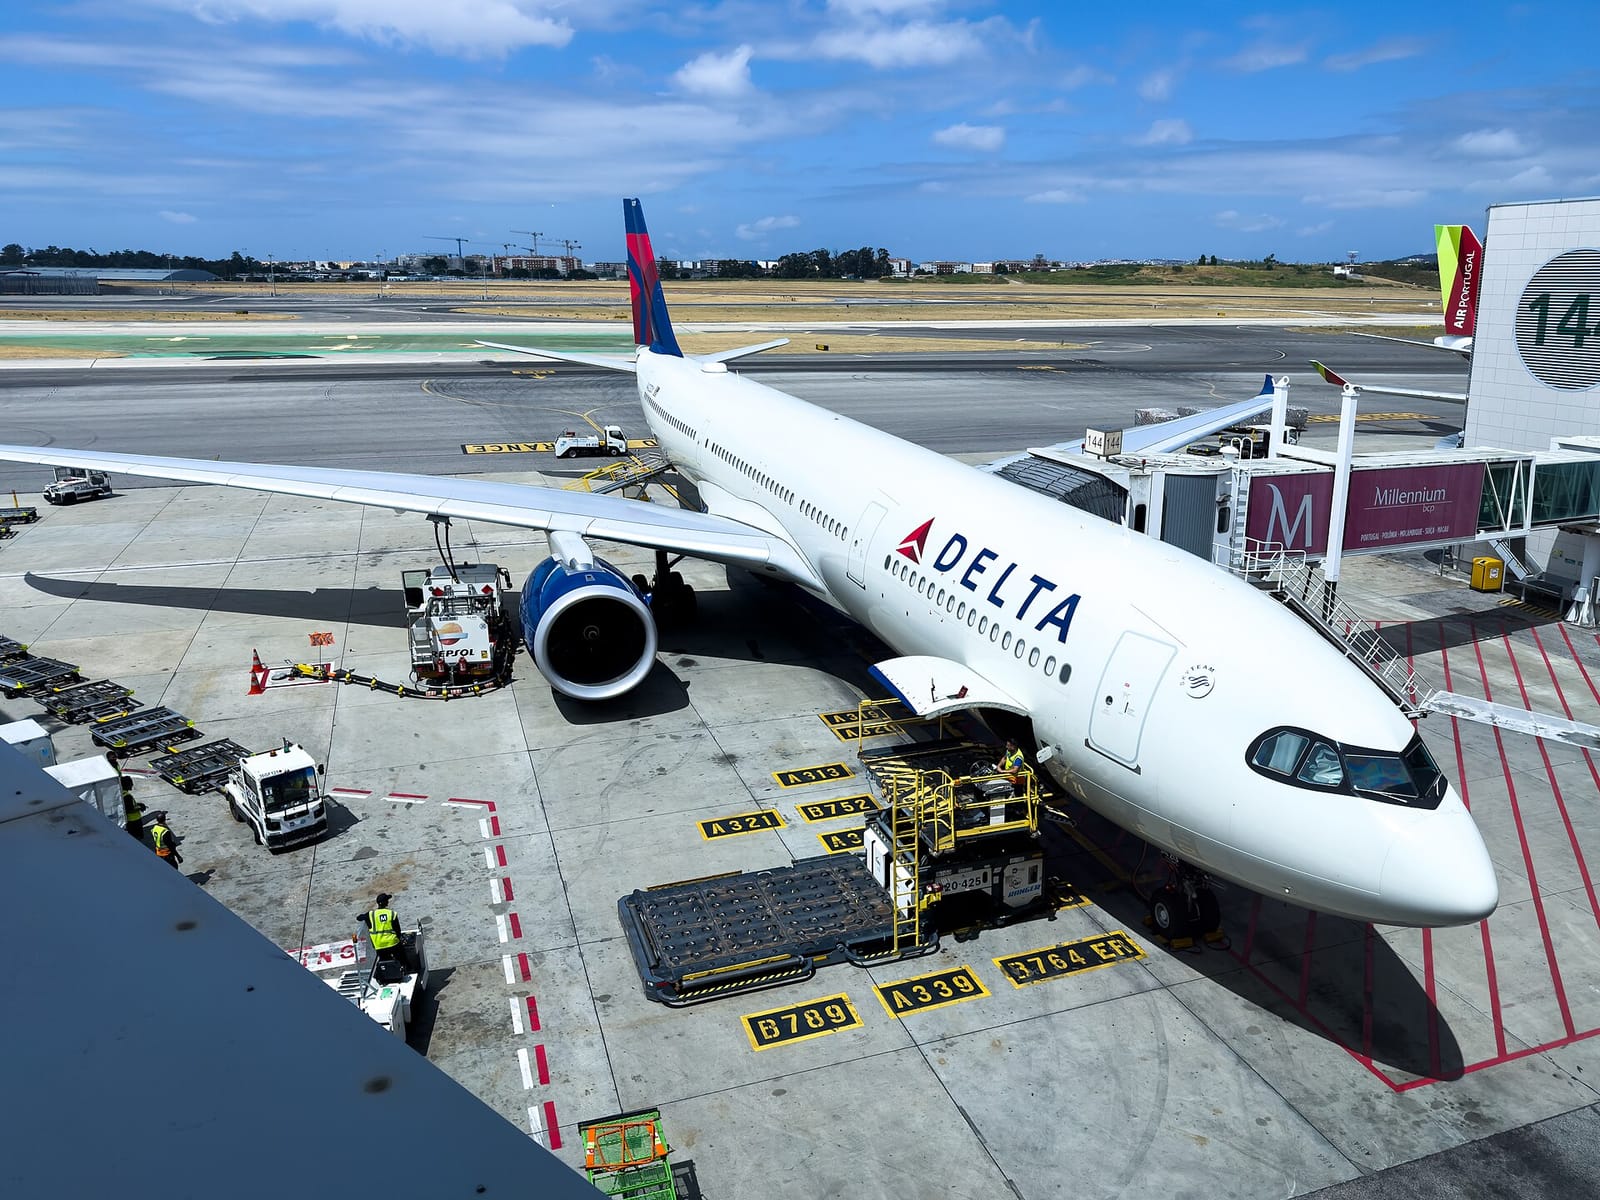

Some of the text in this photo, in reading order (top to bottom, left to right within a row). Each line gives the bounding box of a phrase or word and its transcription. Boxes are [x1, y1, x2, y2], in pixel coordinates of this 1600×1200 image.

[1454, 250, 1475, 329] AIR PORTUGAL
[1528, 292, 1600, 348] 14
[1088, 435, 1102, 450] 144
[1106, 436, 1120, 450] 144
[1374, 487, 1446, 506] Millennium
[1263, 483, 1313, 551] M
[1422, 503, 1435, 513] bcp
[1361, 533, 1380, 542] PORTUGAL
[932, 532, 1082, 644] DELTA
[432, 648, 475, 658] REPSOL
[787, 767, 840, 784] A313
[808, 799, 871, 818] B752
[711, 815, 773, 835] A321
[890, 974, 974, 1009] A339
[757, 1003, 847, 1040] B789
